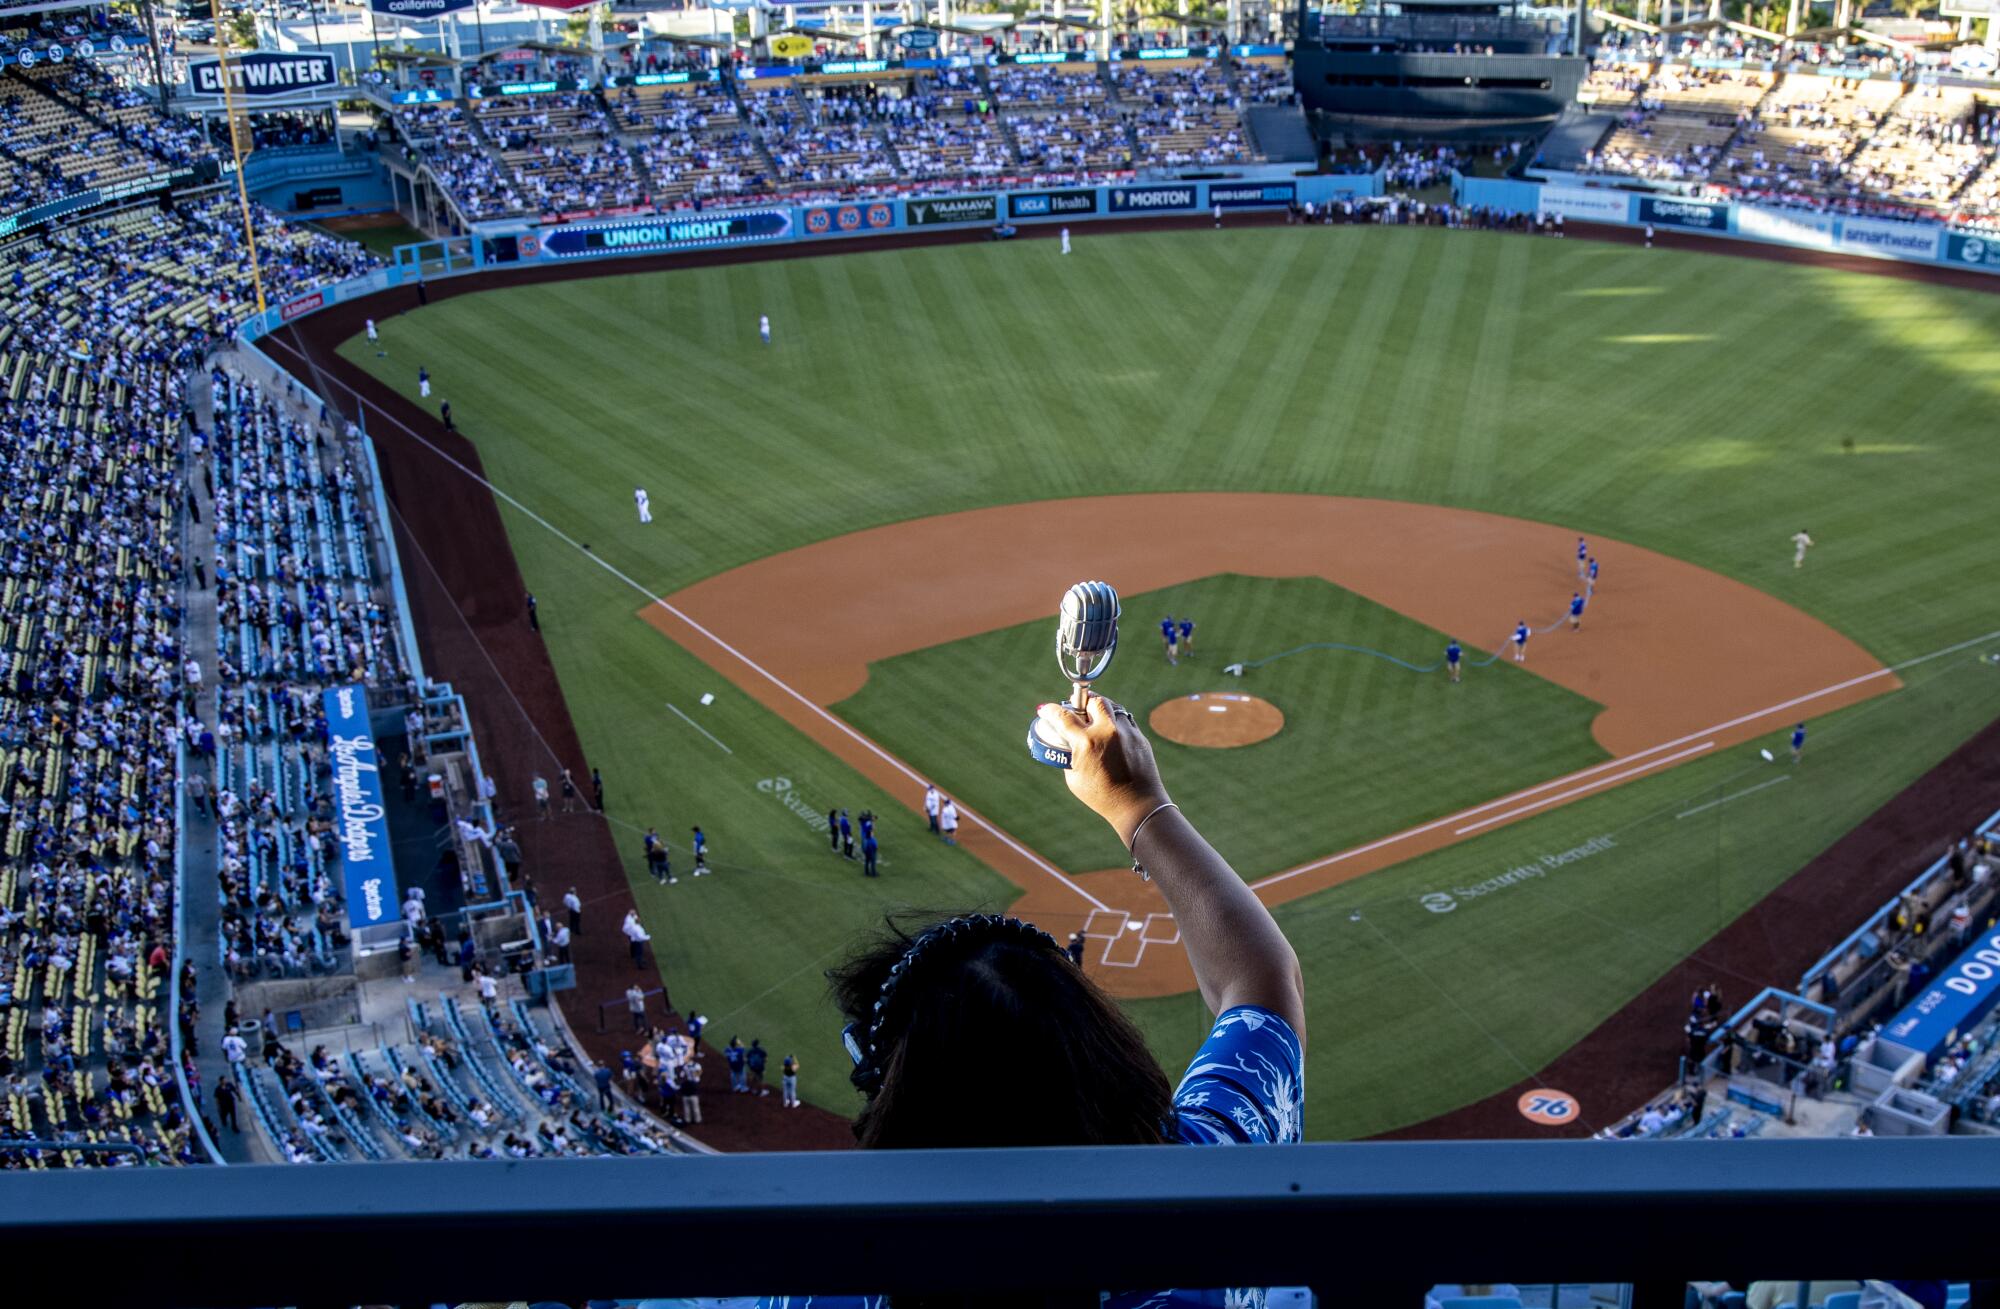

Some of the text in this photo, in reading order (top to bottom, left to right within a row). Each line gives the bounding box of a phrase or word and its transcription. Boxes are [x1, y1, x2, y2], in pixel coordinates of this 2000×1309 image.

[388, 0, 446, 11] california
[1019, 196, 1090, 211] UCLA Health
[1129, 190, 1190, 207] MORTON
[603, 221, 732, 247] UNION NIGHT
[1845, 228, 1932, 251] smartwater
[1044, 749, 1068, 765] 65th
[340, 803, 384, 862] Dodgers
[1453, 833, 1619, 900] Security Benefit
[360, 878, 383, 920] Spectrum
[1527, 1096, 1572, 1117] 76
